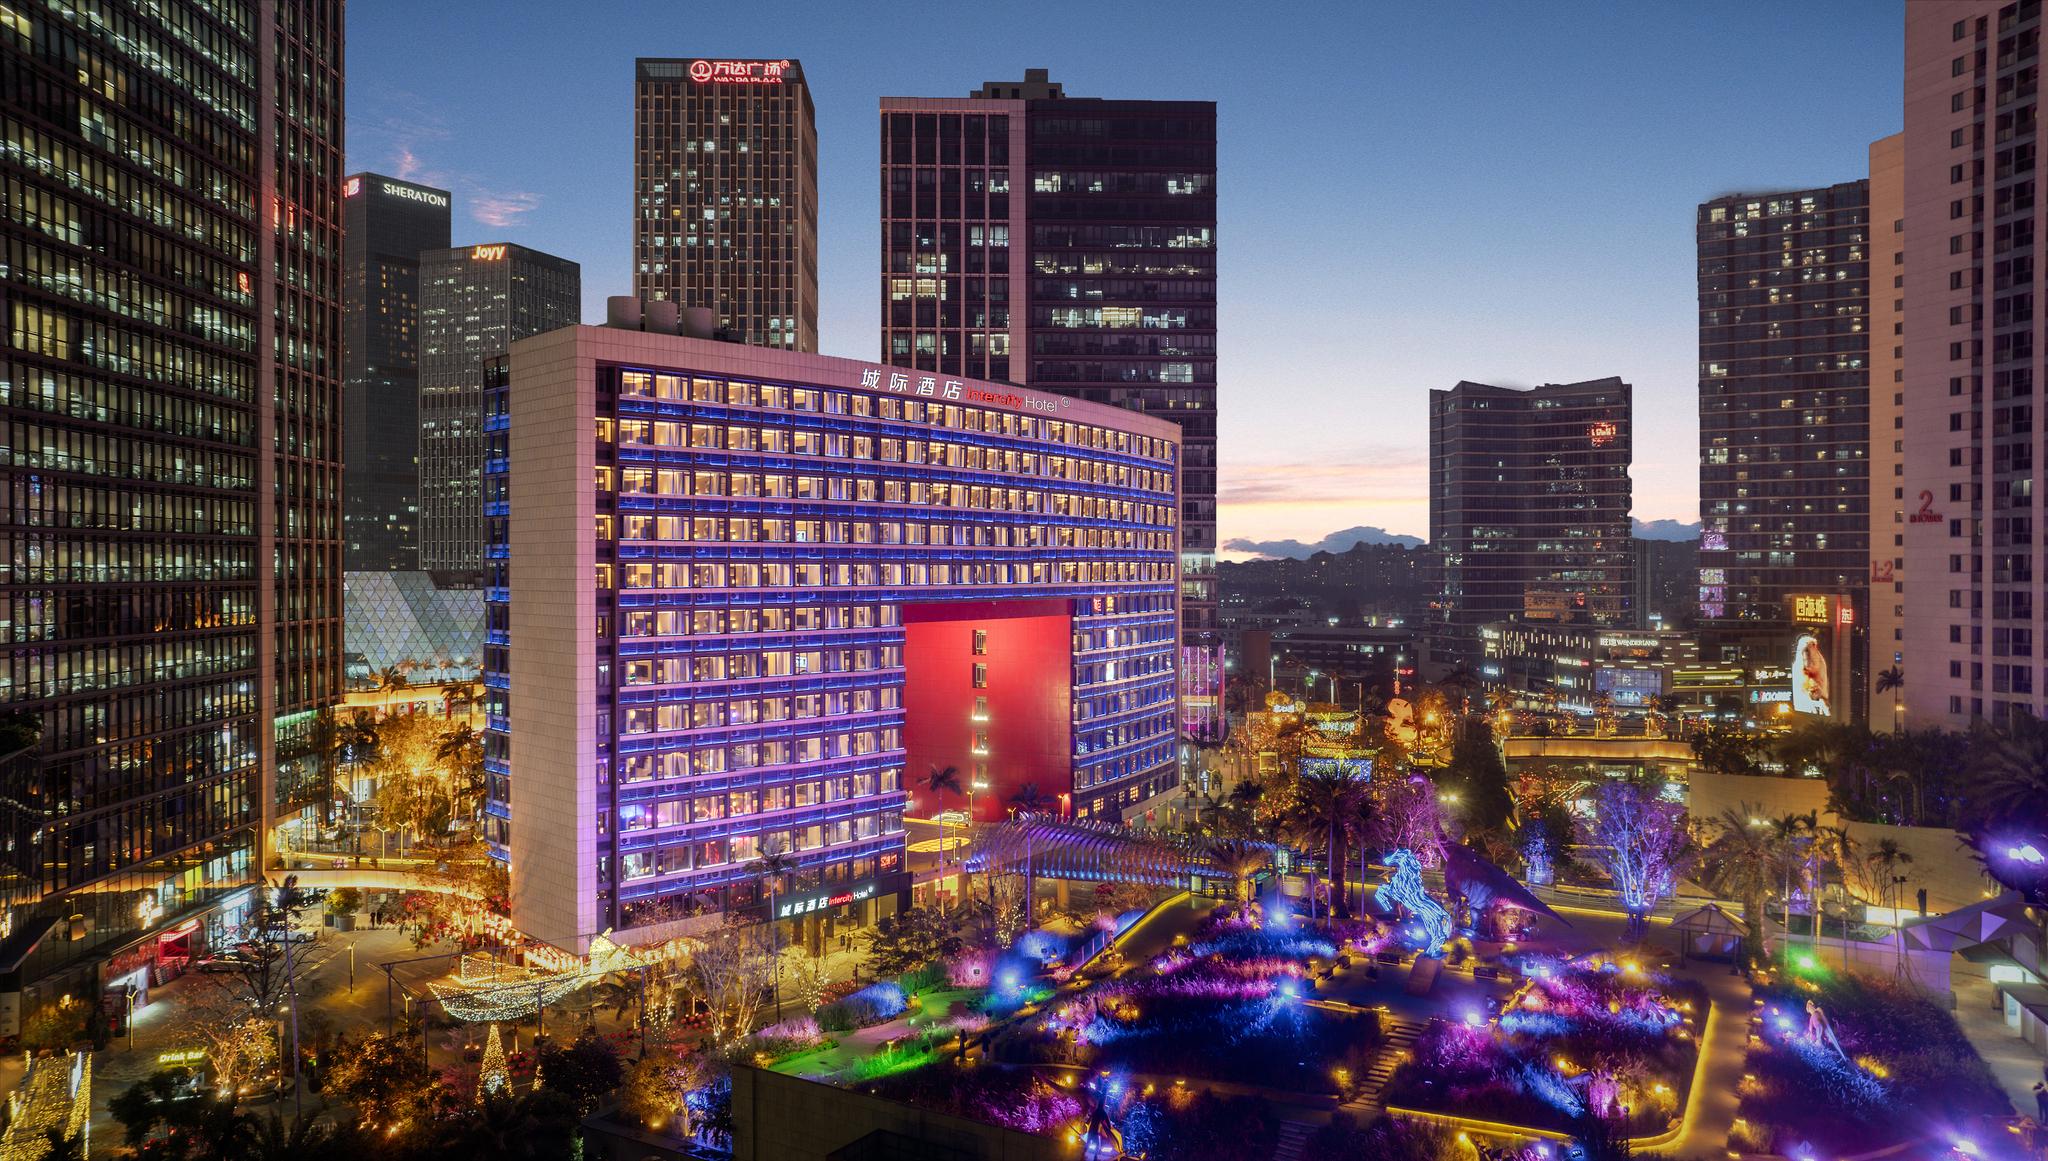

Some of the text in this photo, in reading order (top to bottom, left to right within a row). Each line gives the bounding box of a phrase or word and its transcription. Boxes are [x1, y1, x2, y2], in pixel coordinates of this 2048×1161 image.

[713, 61, 781, 76] 万达广场
[383, 183, 447, 208] SHERATON
[471, 246, 506, 261] Joyy
[860, 368, 1059, 413] 城际酒店 Intercity Hotel
[1919, 489, 1934, 514] 2
[780, 889, 869, 917] 城际酒店 Intercity Hotel
[159, 1051, 186, 1063] Drink
